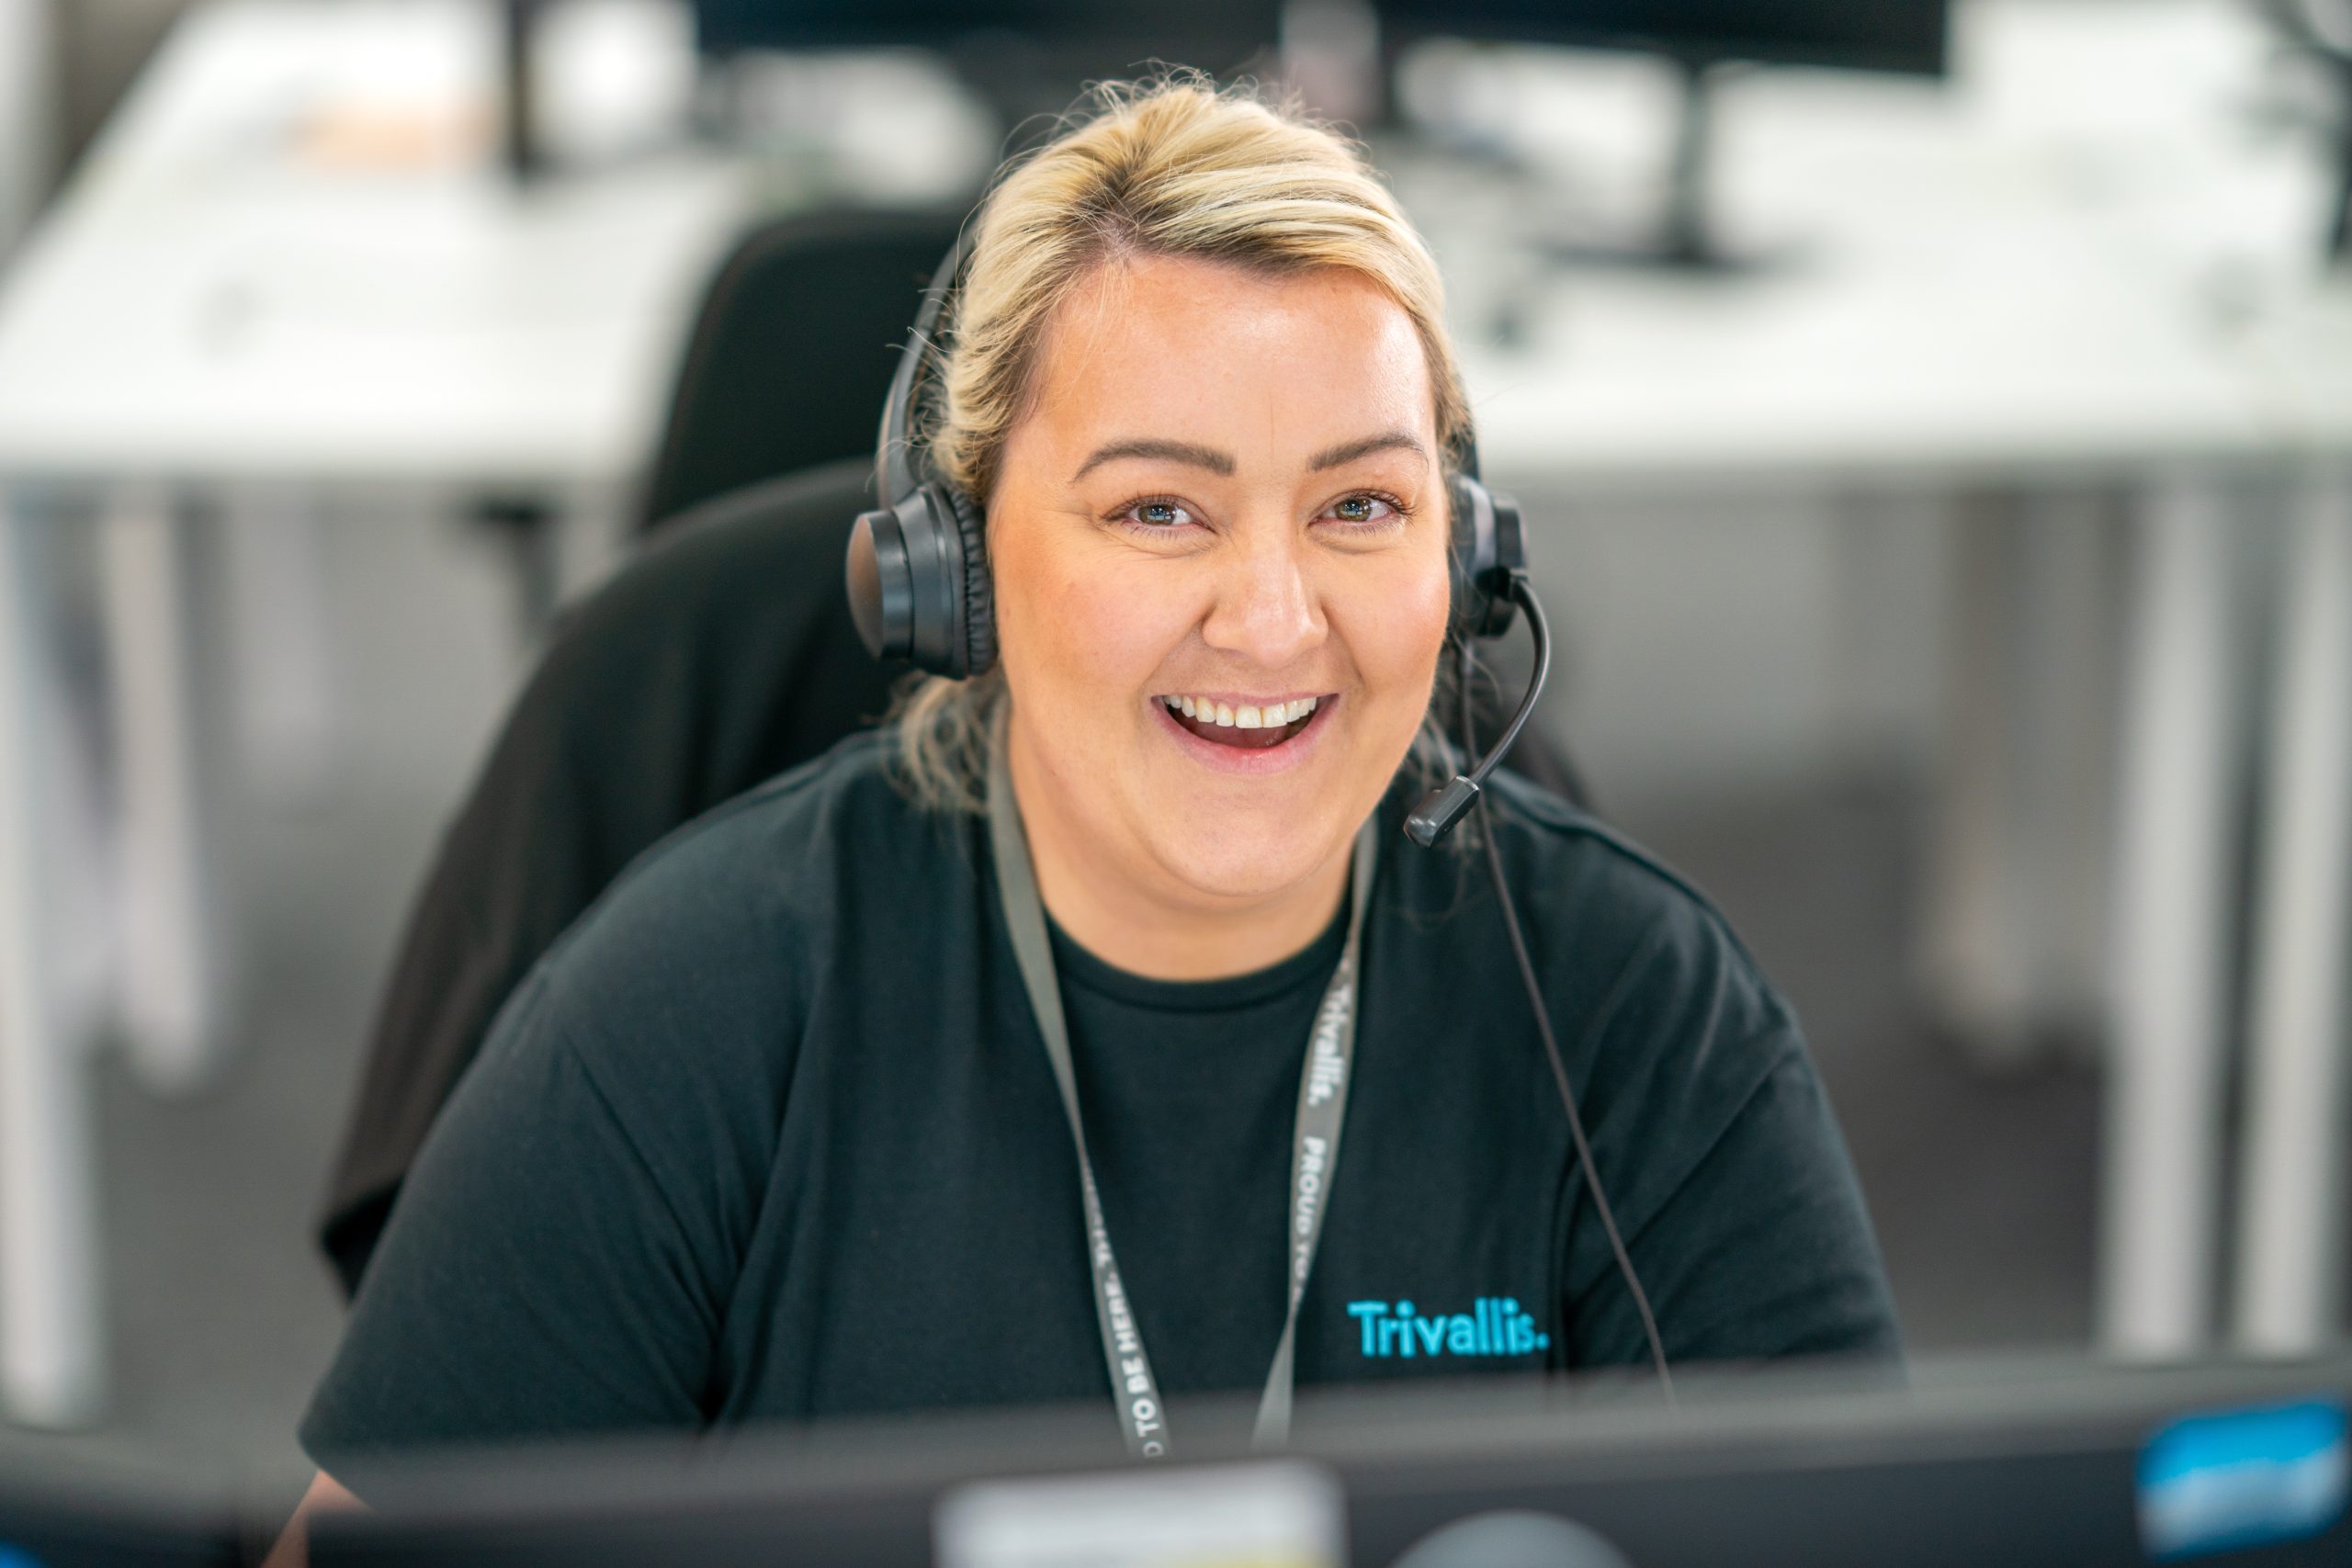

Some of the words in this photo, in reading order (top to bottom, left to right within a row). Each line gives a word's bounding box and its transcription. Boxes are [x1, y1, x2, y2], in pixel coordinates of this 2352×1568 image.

[1295, 1135, 1327, 1235] PROUD
[1346, 1297, 1550, 1358] Trivallis.
[1121, 1357, 1149, 1393] BE
[1132, 1398, 1160, 1438] TO
